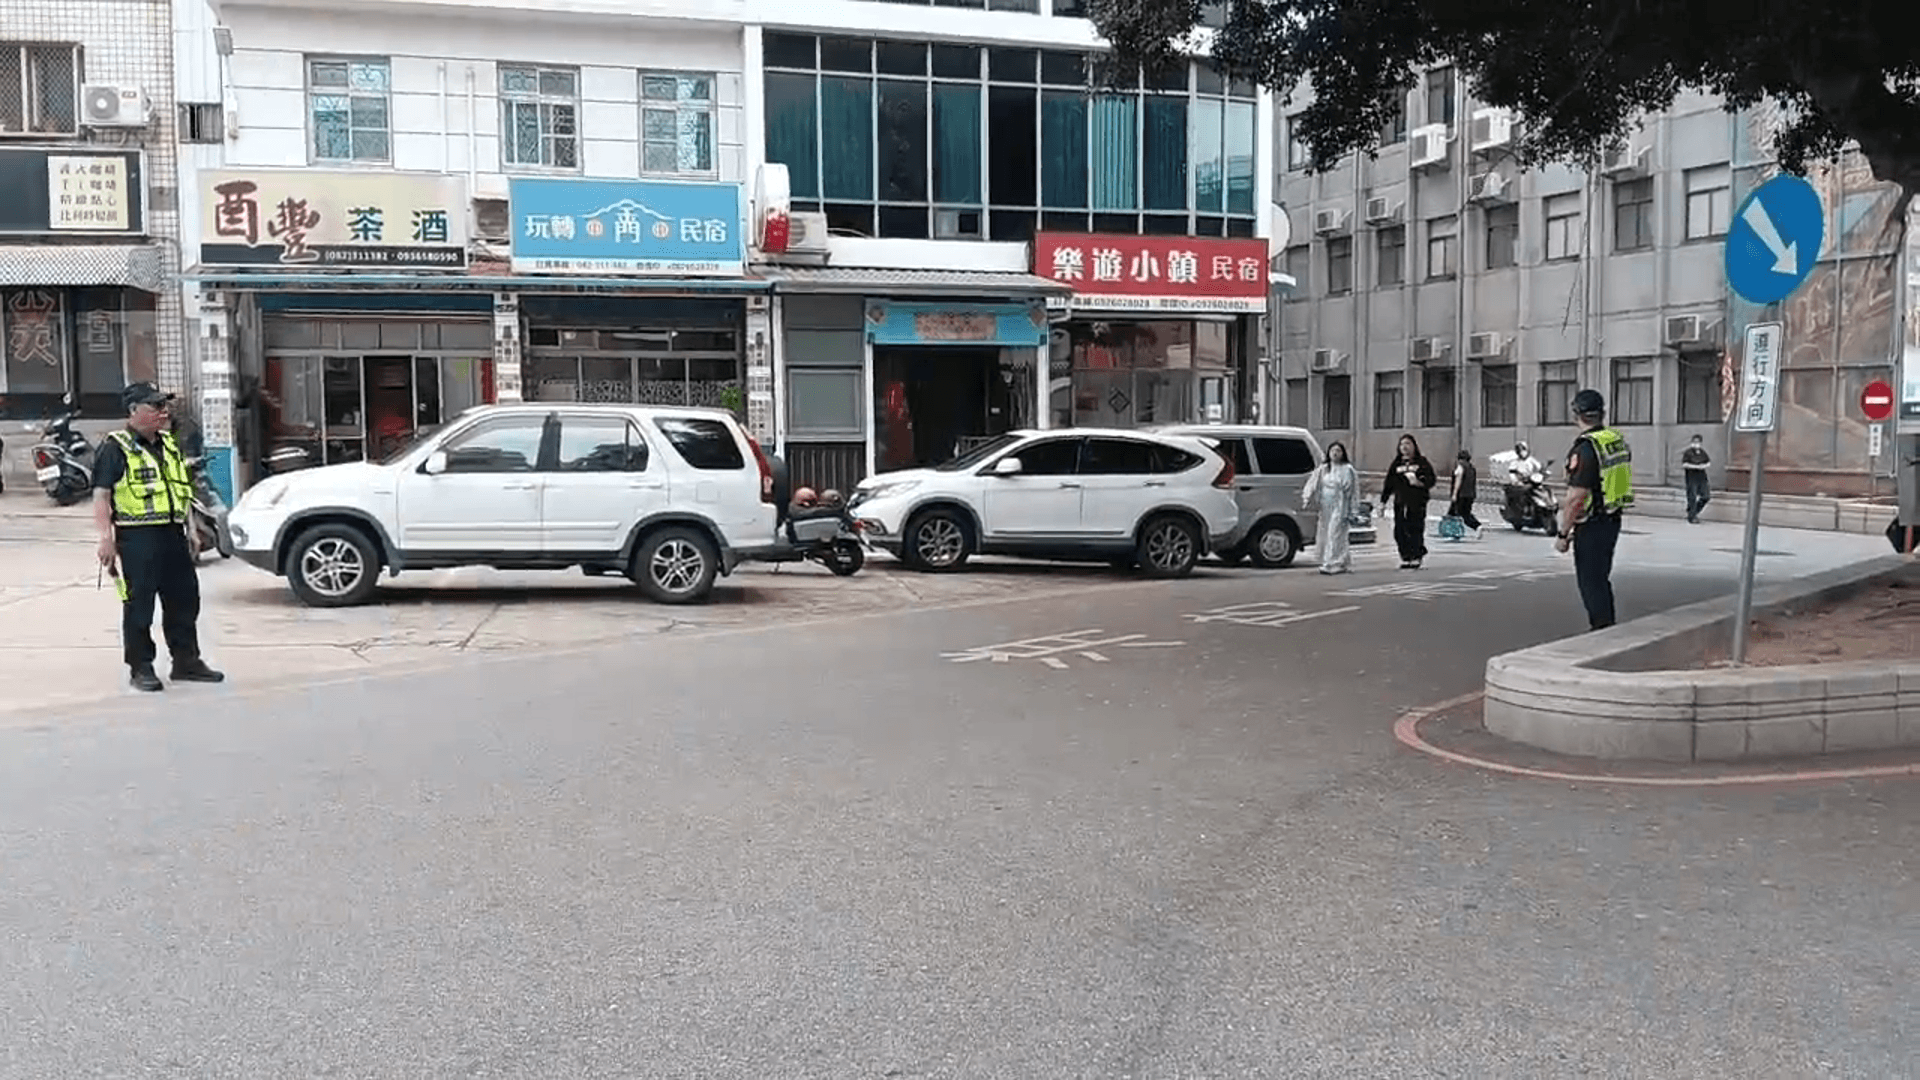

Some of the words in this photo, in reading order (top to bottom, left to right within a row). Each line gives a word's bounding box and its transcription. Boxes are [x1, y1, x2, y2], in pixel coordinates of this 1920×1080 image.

[347, 206, 449, 242] 茶酒
[524, 214, 576, 240] 玩轉
[679, 217, 727, 243] 民宿
[1052, 246, 1198, 283] 樂遊小鎮
[1210, 255, 1259, 281] 民宿
